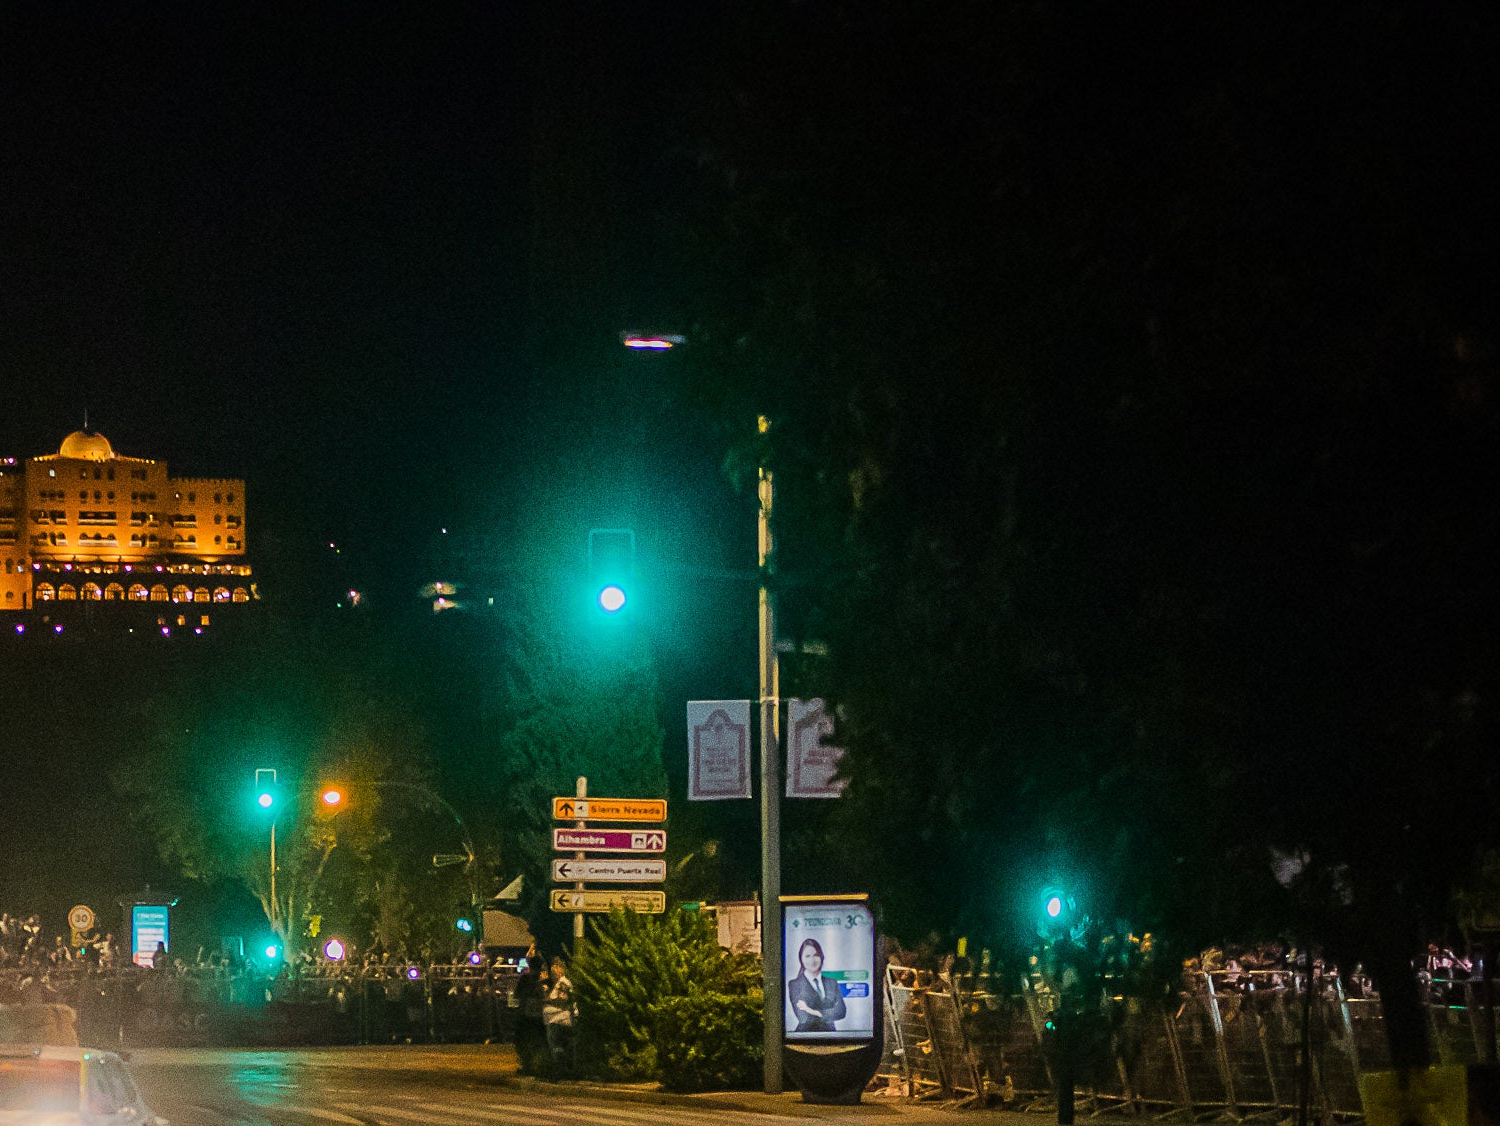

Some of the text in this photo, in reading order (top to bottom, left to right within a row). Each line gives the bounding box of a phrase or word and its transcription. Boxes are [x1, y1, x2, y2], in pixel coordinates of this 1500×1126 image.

[591, 805, 661, 815] Sierra Nevada
[557, 834, 606, 845] Alhambra
[588, 867, 662, 875] Centro Puerta Real
[75, 913, 88, 923] 30
